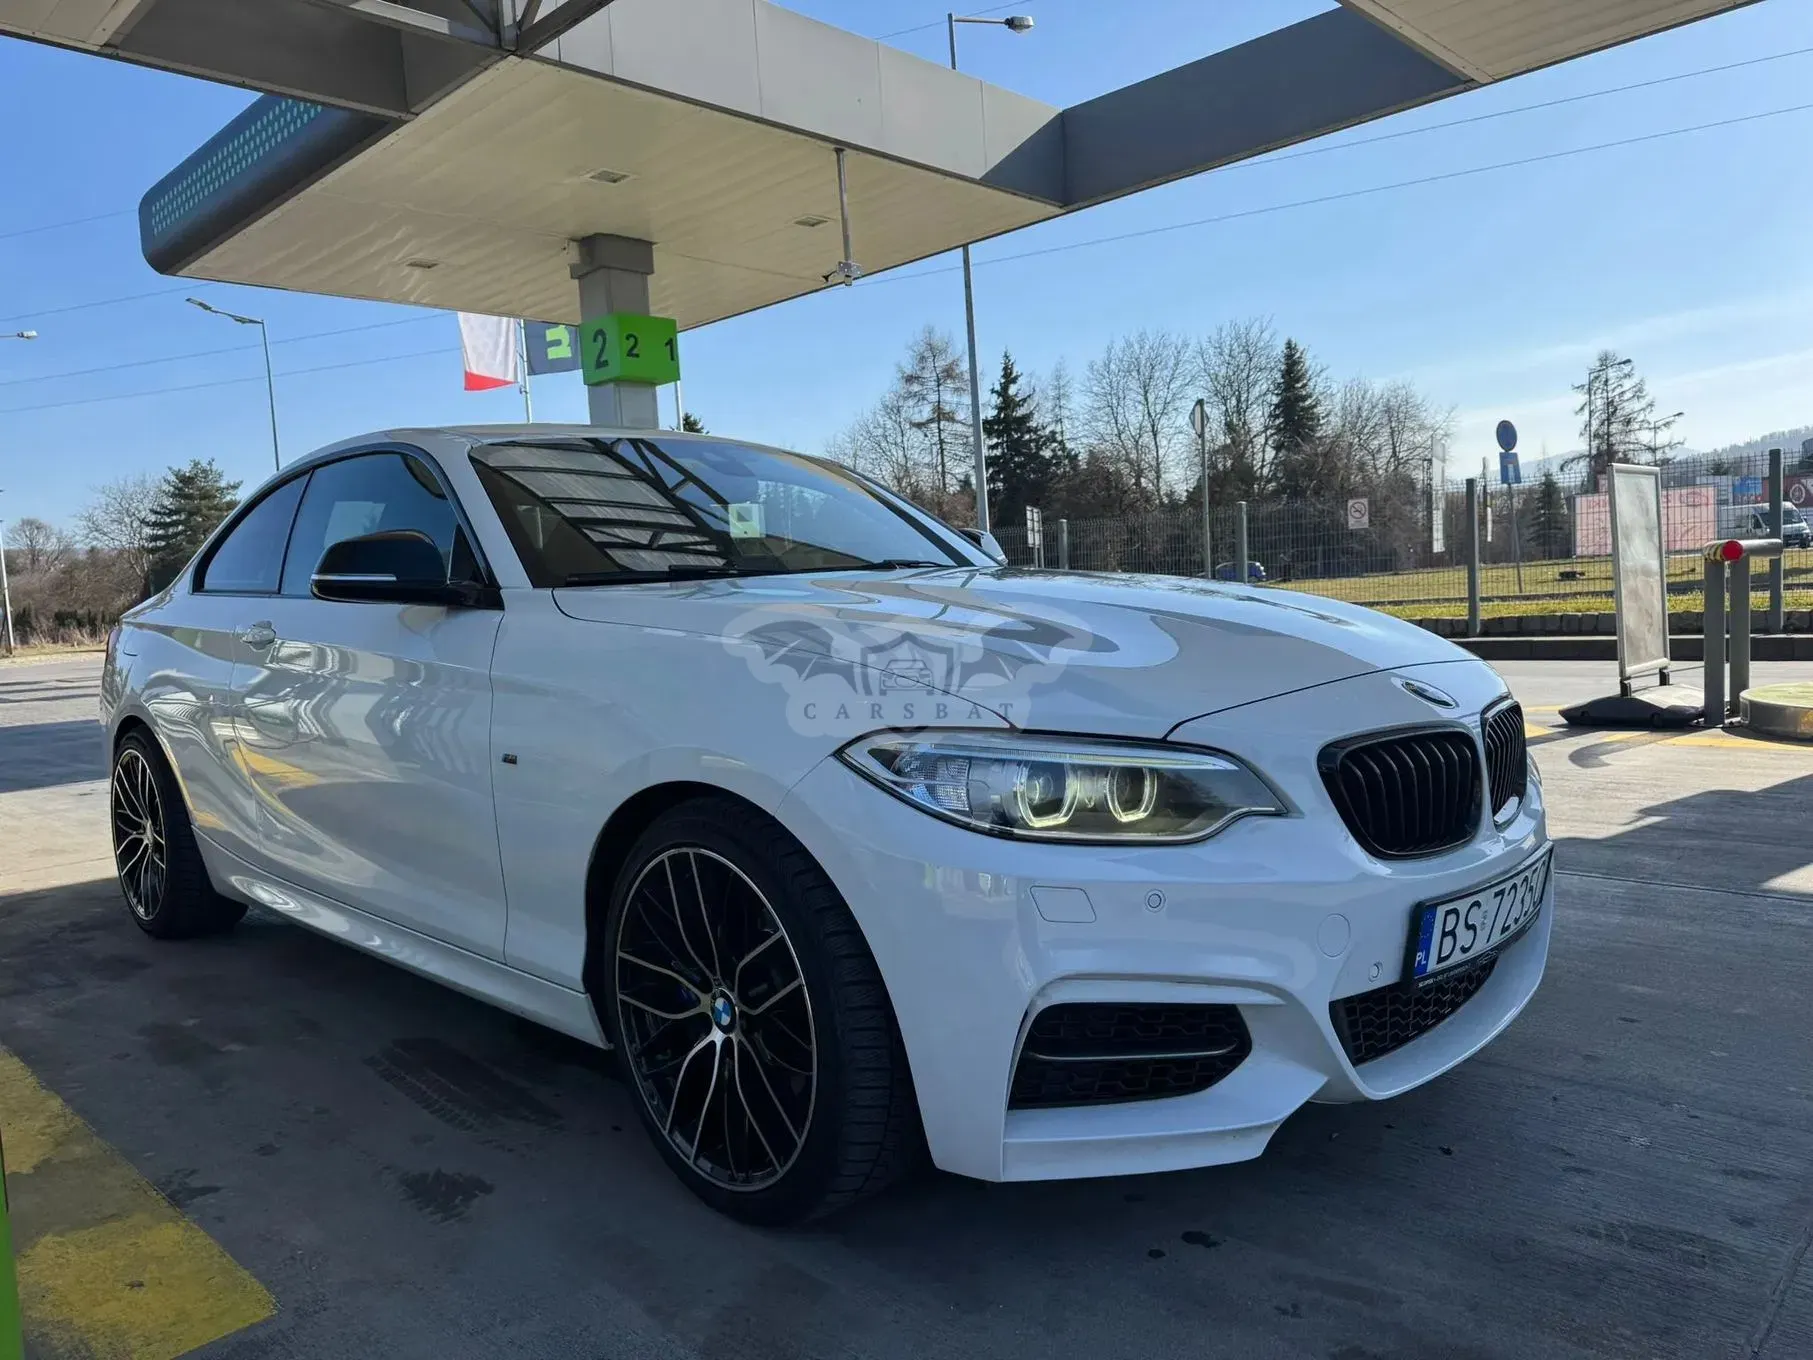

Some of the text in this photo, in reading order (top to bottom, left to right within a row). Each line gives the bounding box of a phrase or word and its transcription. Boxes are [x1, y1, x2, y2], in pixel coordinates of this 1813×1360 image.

[592, 328, 609, 370] 2
[625, 333, 676, 361] 2 1
[1436, 900, 1482, 965] BS
[1414, 951, 1427, 968] PL
